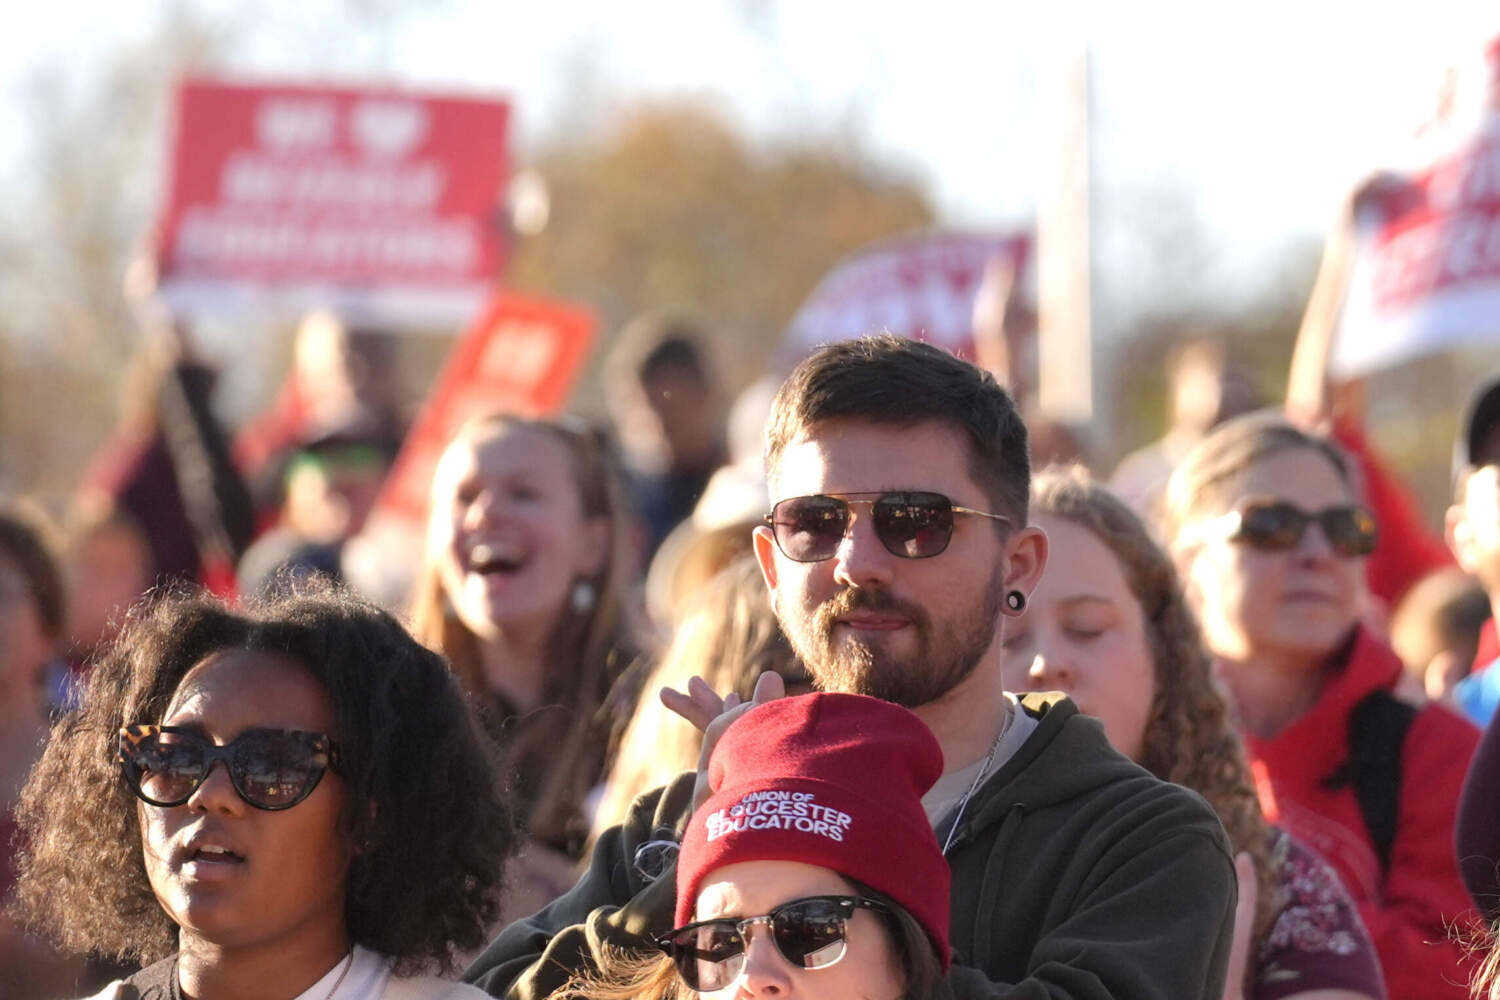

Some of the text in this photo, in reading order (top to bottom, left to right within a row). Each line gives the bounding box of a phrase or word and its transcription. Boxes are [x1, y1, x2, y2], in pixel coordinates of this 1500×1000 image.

[742, 790, 815, 804] UNION OF
[705, 800, 852, 830] GLOUCESTER
[706, 814, 844, 843] EDUCATORS
